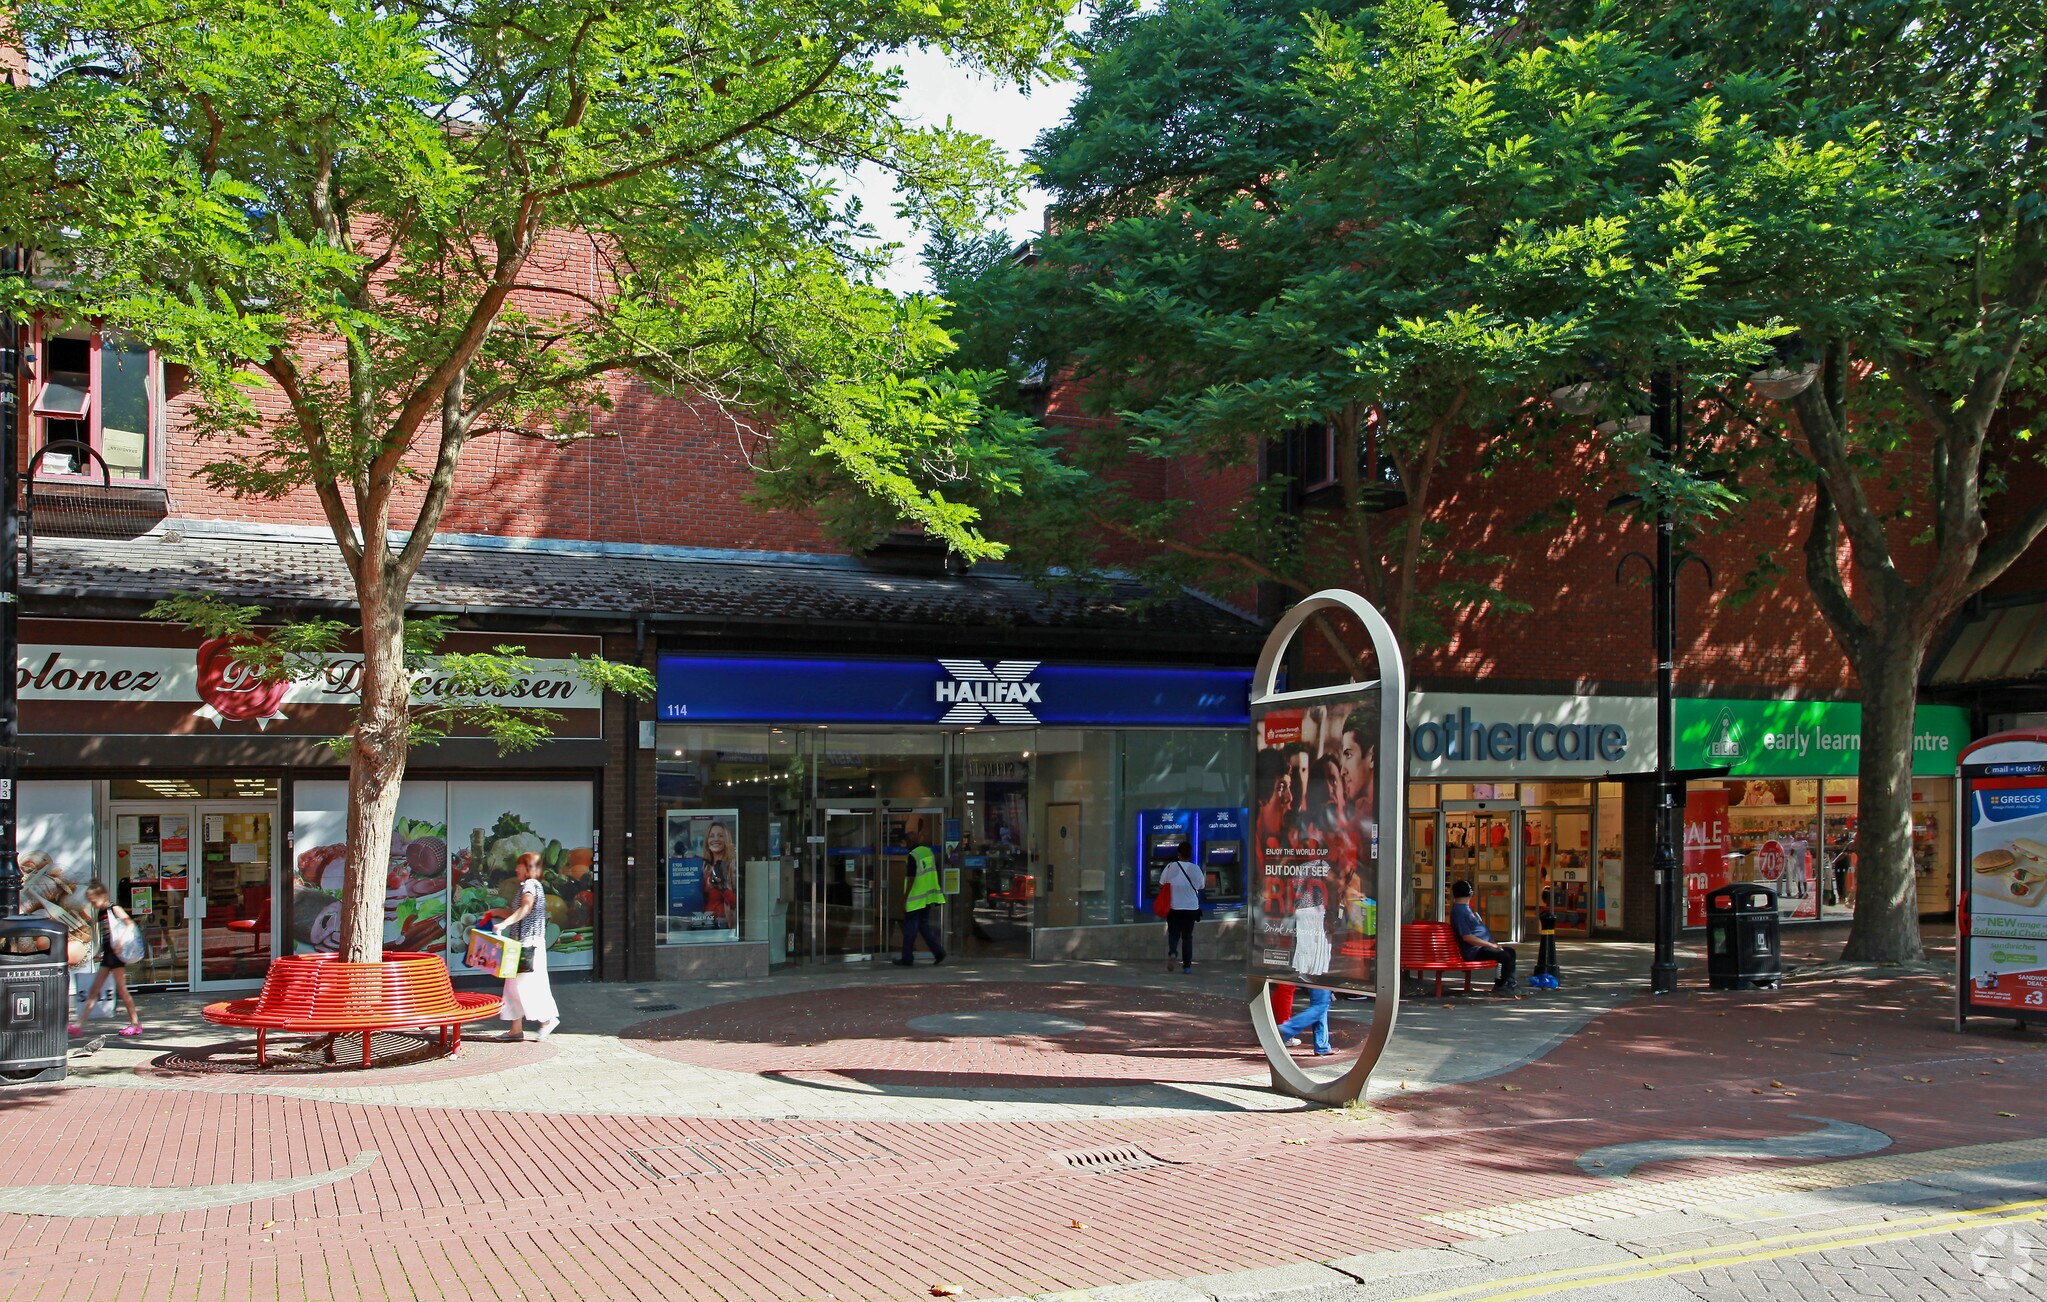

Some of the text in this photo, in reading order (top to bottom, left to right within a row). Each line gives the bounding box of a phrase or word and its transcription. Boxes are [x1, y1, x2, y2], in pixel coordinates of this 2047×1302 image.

[17, 652, 161, 692] olonez
[936, 681, 1042, 703] HALIFAX
[667, 704, 688, 716] 114
[1413, 706, 1628, 762] othercare
[1763, 725, 1949, 757] early learn ntre
[1712, 742, 1739, 755] ELC
[1992, 765, 2009, 773] mail
[2015, 765, 2031, 773] text
[2, 780, 9, 788] 3
[2, 790, 8, 798] 3
[2000, 795, 2042, 804] GREGGS
[1684, 821, 1722, 844] ALE
[1265, 848, 1329, 856] ENJOY THE WORLD CUP
[1265, 864, 1329, 877] BUT DON'T SEE
[1265, 877, 1329, 914] RED
[1263, 922, 1285, 935] Drink
[1987, 917, 2017, 927] NEW
[2017, 922, 2041, 930] range
[1973, 927, 2017, 936] Balanced
[1990, 943, 2036, 951] sandwiches
[7, 969, 42, 978] LITTER
[2024, 990, 2043, 1005] £3
